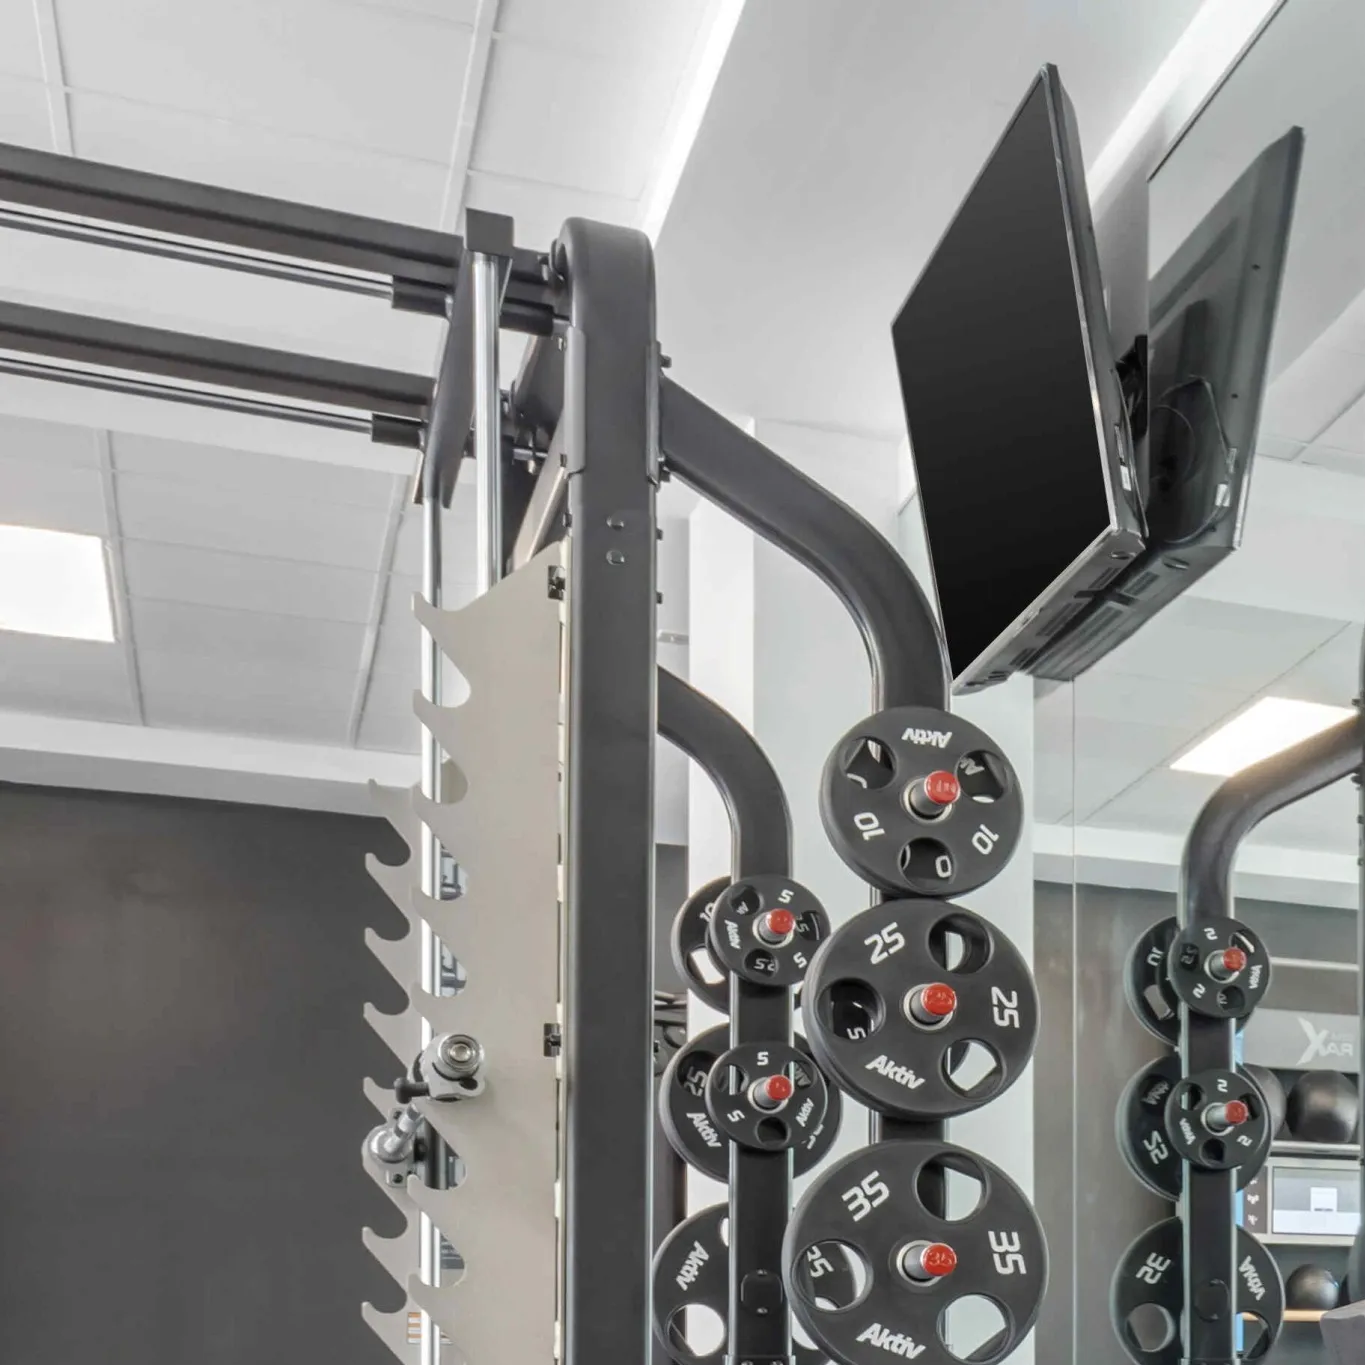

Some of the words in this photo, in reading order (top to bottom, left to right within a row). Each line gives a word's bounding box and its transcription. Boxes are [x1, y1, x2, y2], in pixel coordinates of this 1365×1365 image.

[901, 727, 952, 748] Aktiv
[853, 811, 885, 841] 10
[971, 824, 1000, 855] 10
[777, 889, 794, 904] 5
[793, 951, 807, 969] 5
[864, 921, 906, 965] 25
[990, 986, 1020, 1029] 25
[756, 1051, 769, 1066] 5
[865, 1054, 926, 1090] Aktiv
[686, 1111, 722, 1148] Aktiv
[727, 1109, 745, 1122] 5
[841, 1170, 890, 1222] 35
[676, 1240, 710, 1291] Aktiv
[987, 1230, 1027, 1275] 35
[855, 1322, 927, 1360] Aktiv
